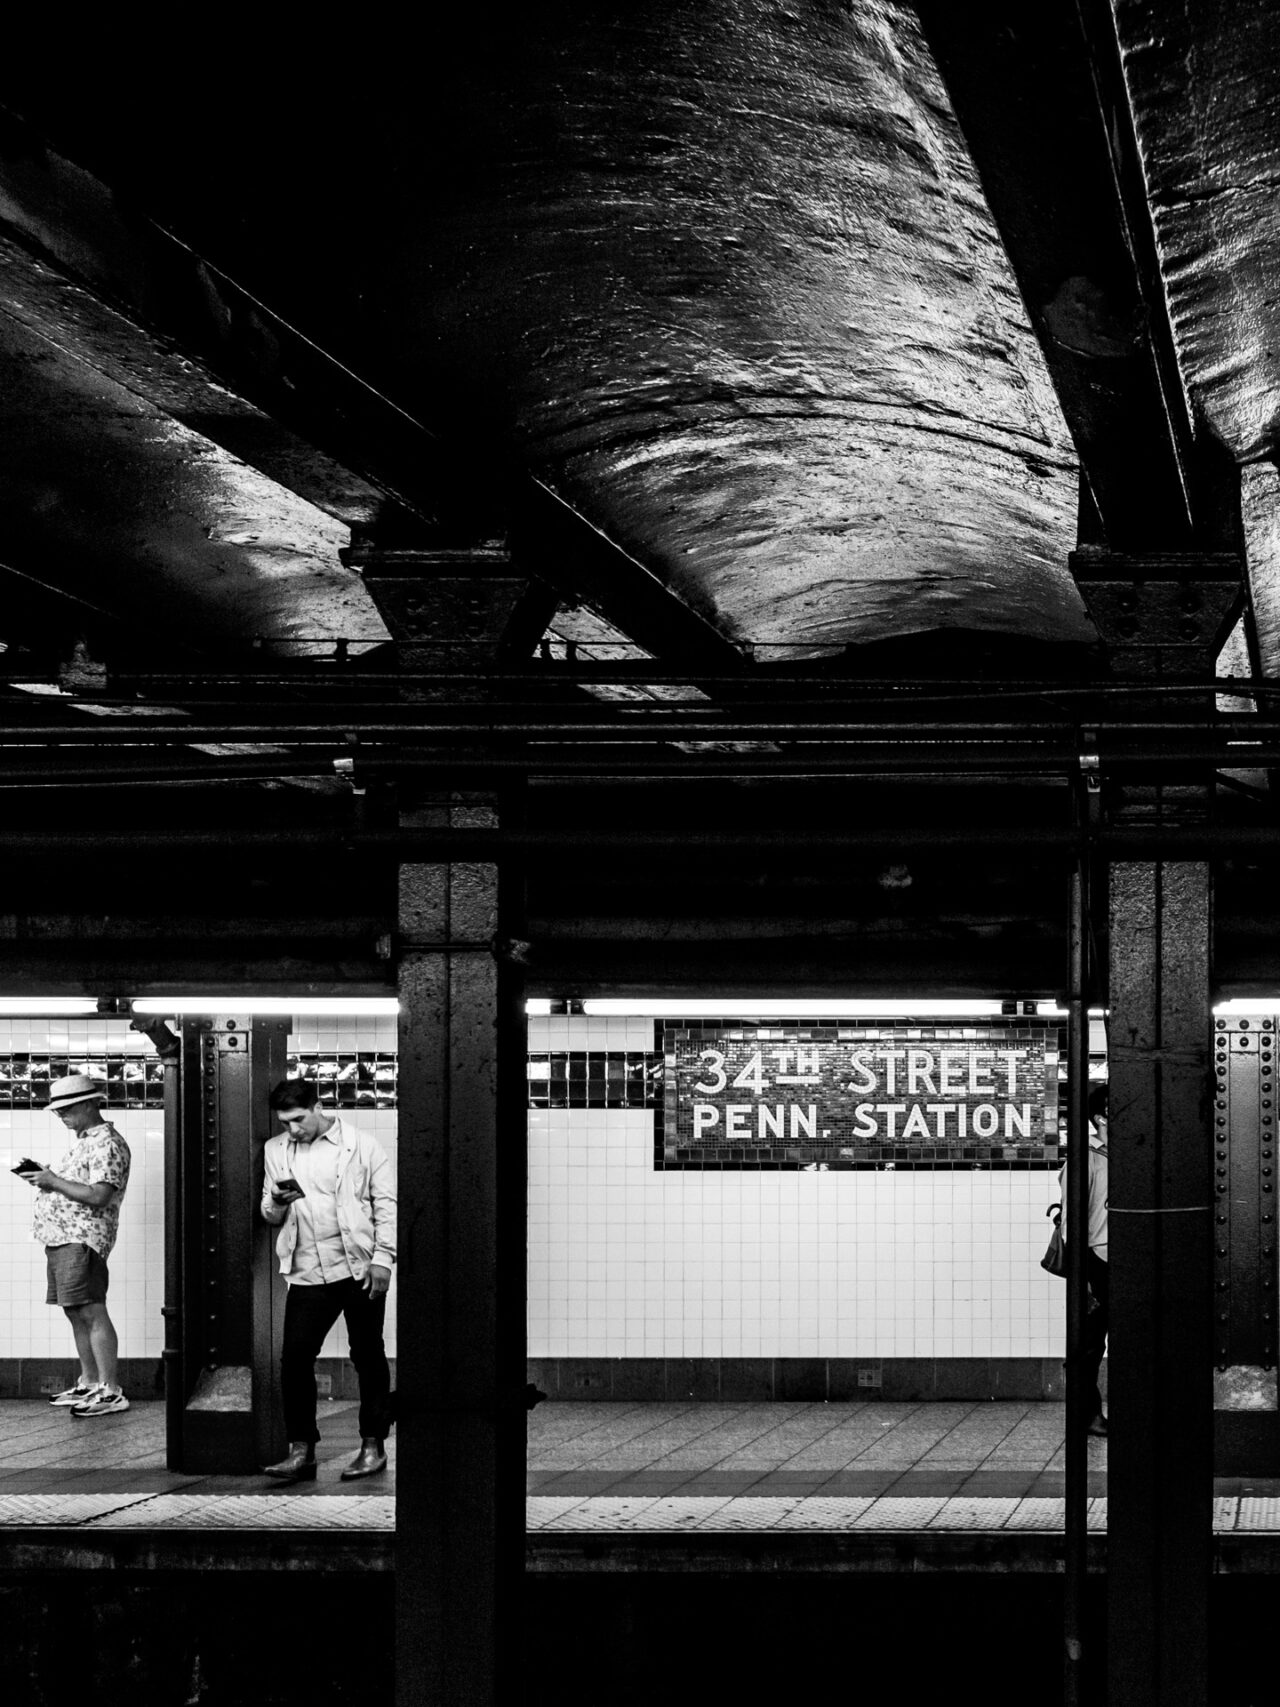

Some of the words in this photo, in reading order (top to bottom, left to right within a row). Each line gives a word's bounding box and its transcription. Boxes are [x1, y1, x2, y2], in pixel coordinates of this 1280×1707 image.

[696, 1049, 820, 1095] 34TH
[847, 1049, 1027, 1095] STREET
[693, 1104, 831, 1138] PENN.
[852, 1103, 1031, 1138] STATION
